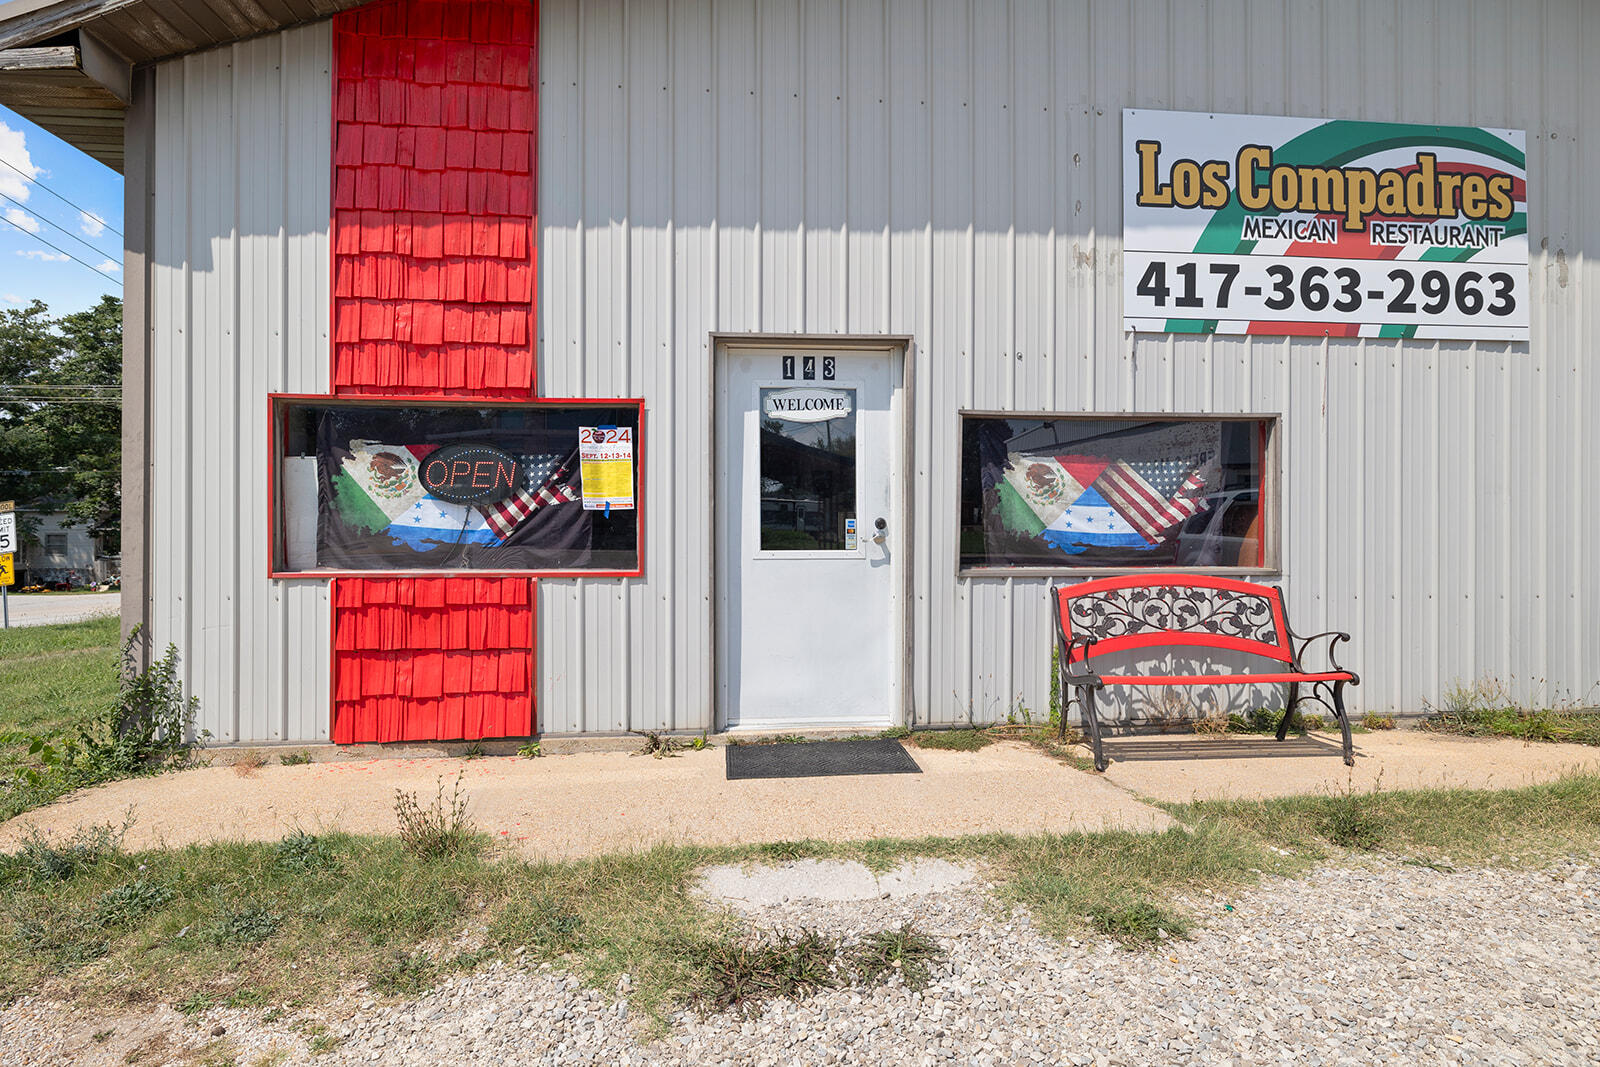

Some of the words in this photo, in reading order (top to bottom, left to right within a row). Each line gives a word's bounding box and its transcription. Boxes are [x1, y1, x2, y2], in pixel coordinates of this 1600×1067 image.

[1136, 140, 1230, 209] Los
[1236, 143, 1514, 233] Compadres
[1242, 215, 1337, 244] MEXICAN
[1370, 222, 1504, 248] RESTAURANT
[1136, 261, 1516, 316] 417-363-2963
[784, 358, 834, 377] 143
[772, 398, 844, 411] WELCOME
[426, 460, 516, 488] OPEN
